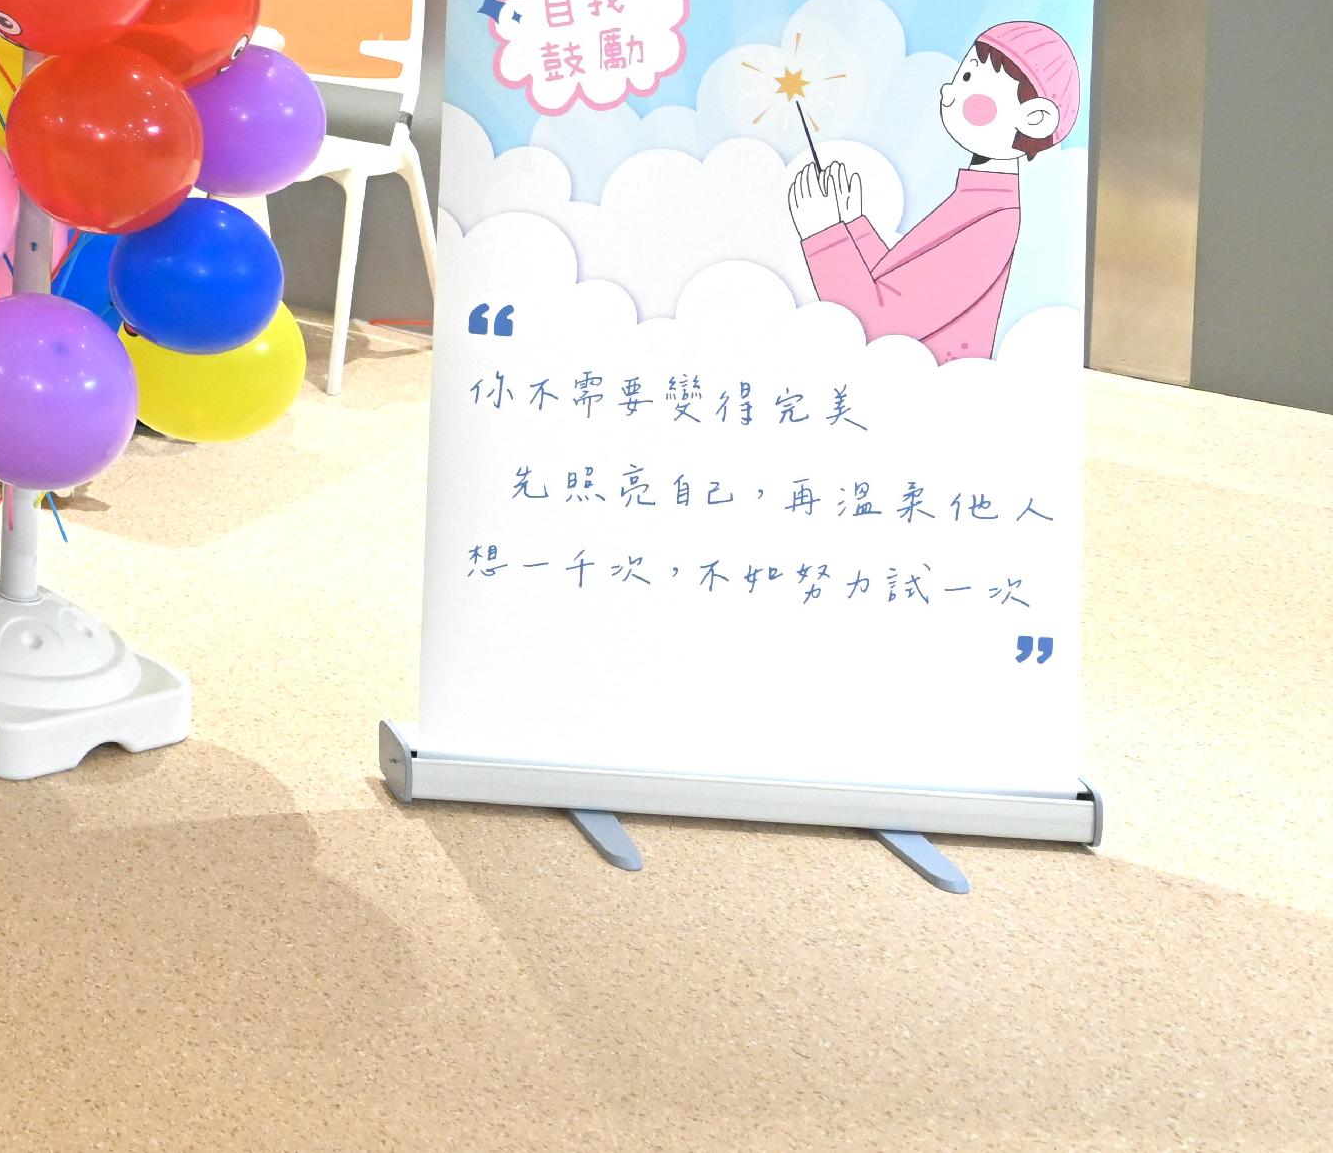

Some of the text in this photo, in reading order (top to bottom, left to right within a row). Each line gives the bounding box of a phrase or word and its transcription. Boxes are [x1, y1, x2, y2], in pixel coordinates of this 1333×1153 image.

[539, 27, 644, 82] 鼓勵
[470, 370, 869, 431] 你不需要變得完美
